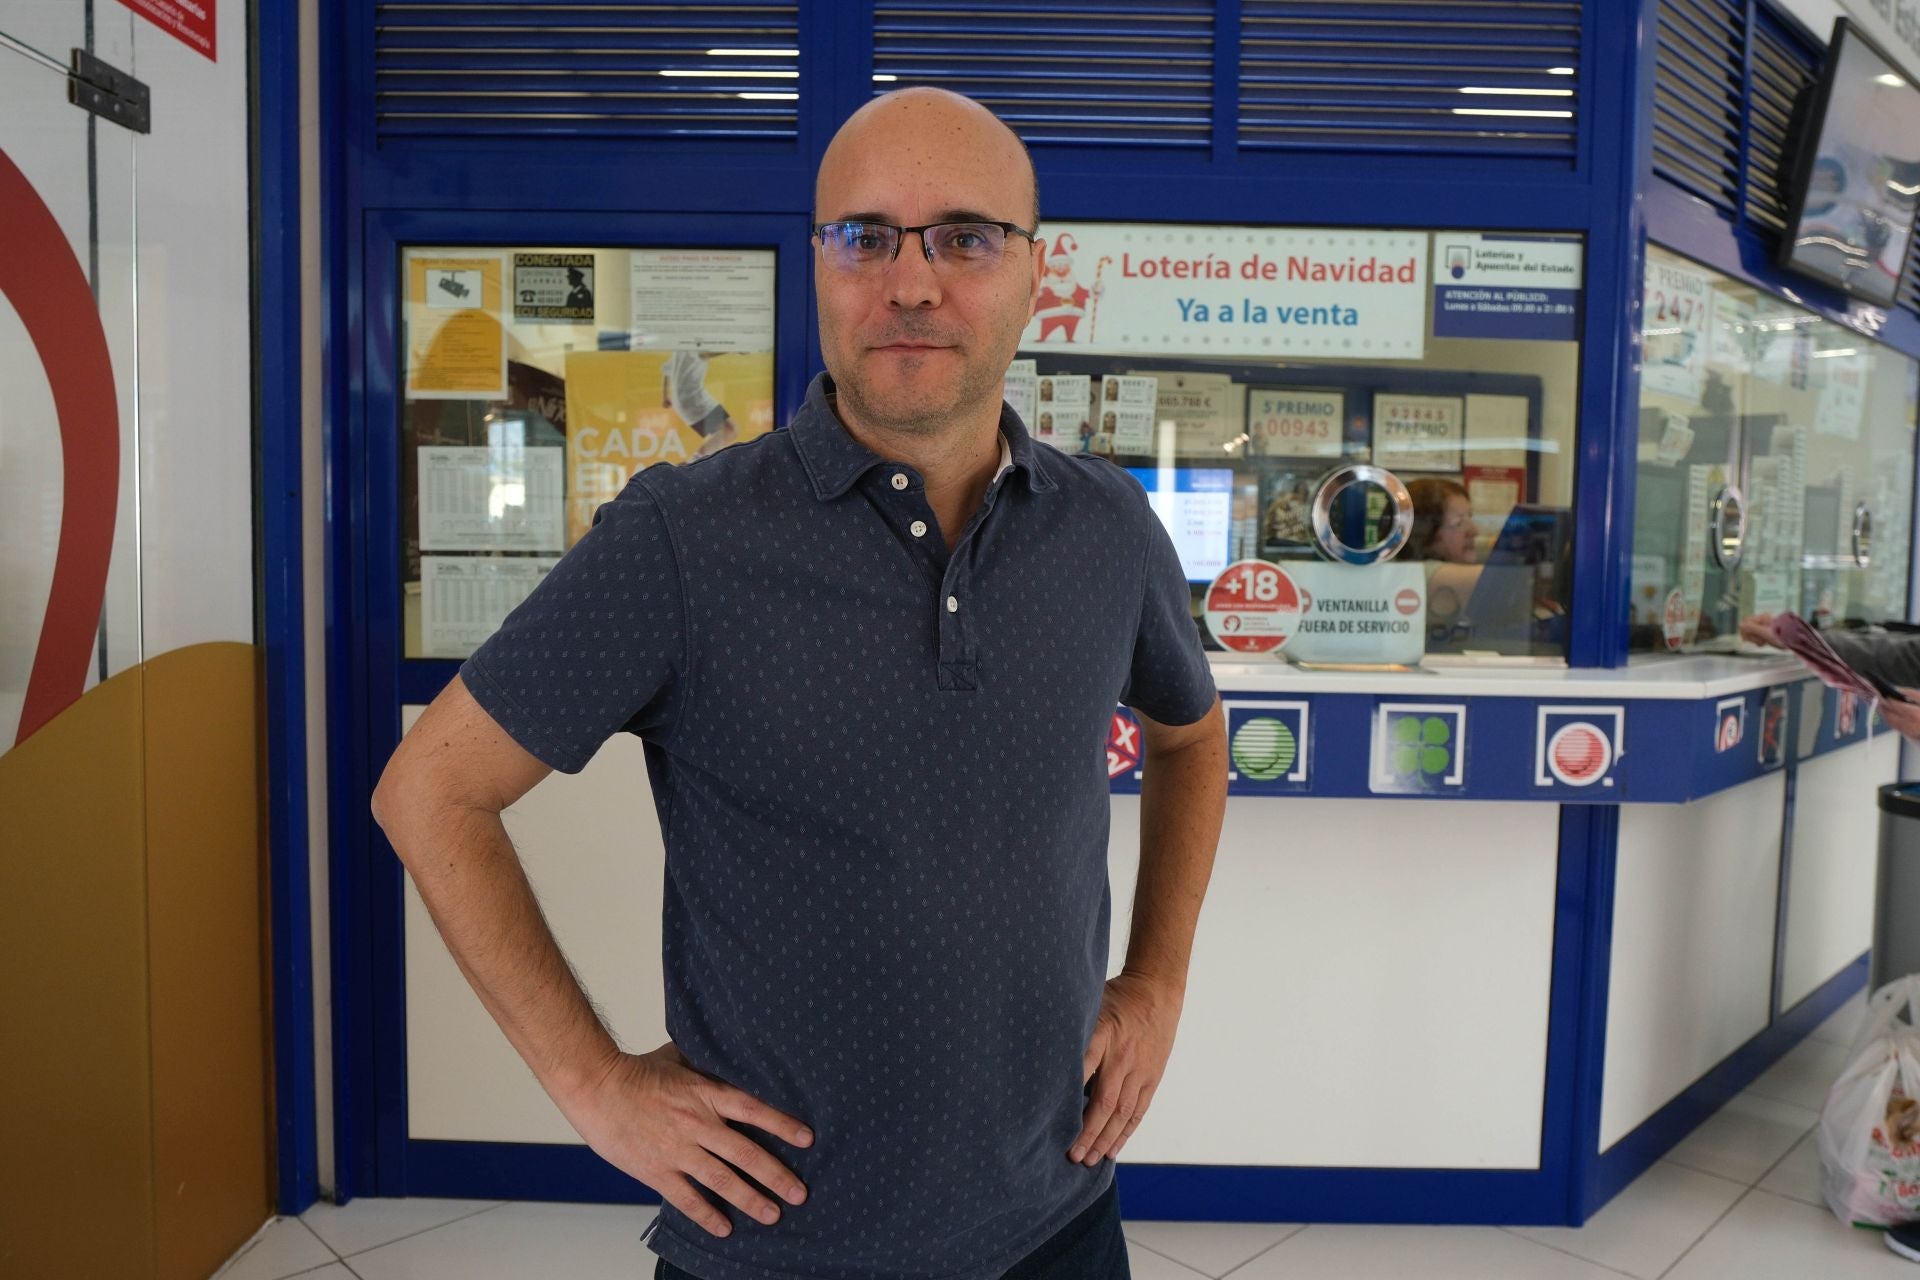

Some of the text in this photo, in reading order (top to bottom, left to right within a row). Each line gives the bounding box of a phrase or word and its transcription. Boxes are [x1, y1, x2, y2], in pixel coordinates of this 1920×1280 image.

[515, 255, 593, 266] CONECTADA
[1518, 253, 1524, 262] y
[1122, 253, 1416, 284] Lotería de Navidad
[1475, 261, 1575, 274] Apuestas del Estado
[1445, 288, 1492, 301] ATENCIÓN
[1494, 291, 1504, 301] AL
[537, 307, 593, 319] SEGURIDAD
[1176, 299, 1359, 326] Ya a la venta
[1277, 400, 1335, 417] PREMIO
[1267, 418, 1329, 438] 00943
[574, 427, 687, 458] CADA
[1225, 569, 1279, 602] +18
[1316, 600, 1389, 614] VENTANILLA
[1298, 619, 1335, 633] FUERA
[1338, 620, 1352, 633] DE
[1356, 620, 1410, 634] SERVICIO
